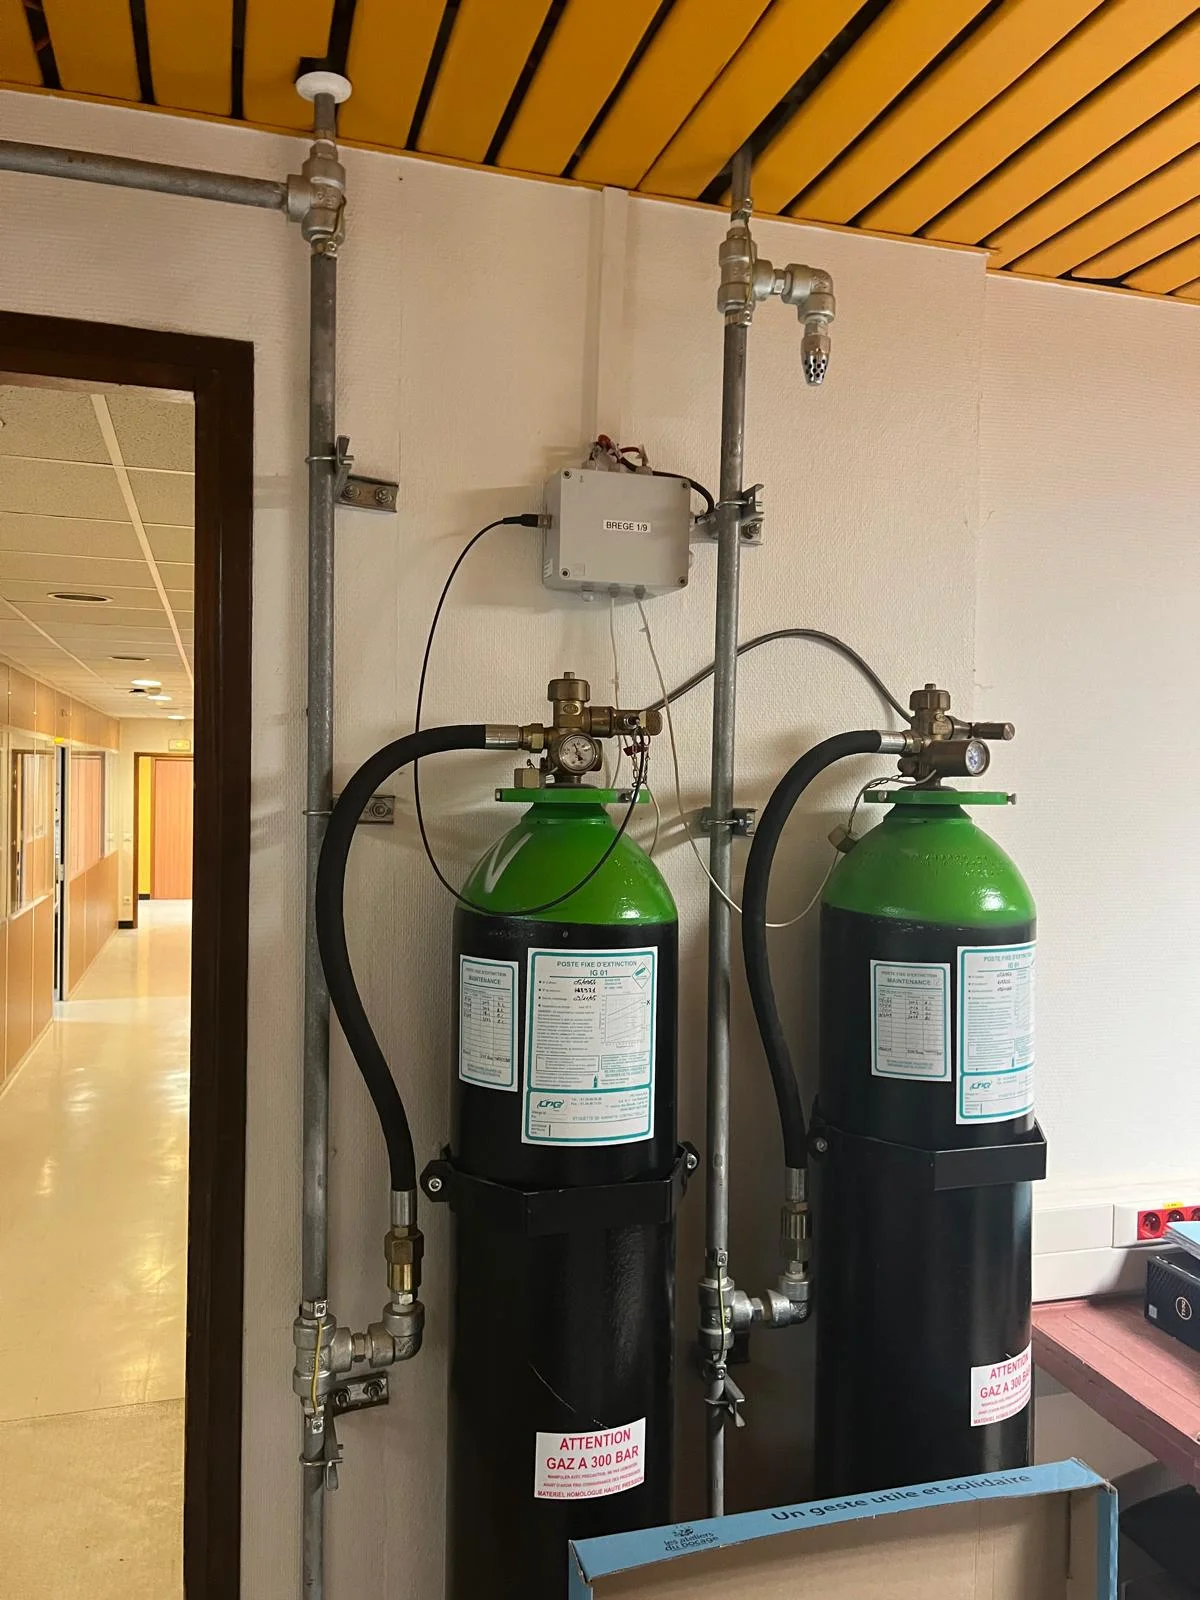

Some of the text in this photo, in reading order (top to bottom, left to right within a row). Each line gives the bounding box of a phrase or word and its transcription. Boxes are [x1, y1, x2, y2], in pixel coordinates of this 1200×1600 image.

[606, 521, 648, 532] BREGE 1/9
[599, 969, 609, 977] 01
[990, 1353, 1029, 1379] ATTENTION
[980, 1384, 1001, 1398] GAZ
[1003, 1382, 1009, 1393] A
[1010, 1375, 1022, 1390] 300
[560, 1428, 631, 1451] ATTENTION
[546, 1457, 575, 1470] GAZ
[578, 1457, 587, 1470] A
[591, 1453, 612, 1468] 300
[615, 1445, 639, 1464] BAR
[537, 1490, 566, 1498] MATERIEL
[771, 1475, 1033, 1521] Un geste utile et solidaire
